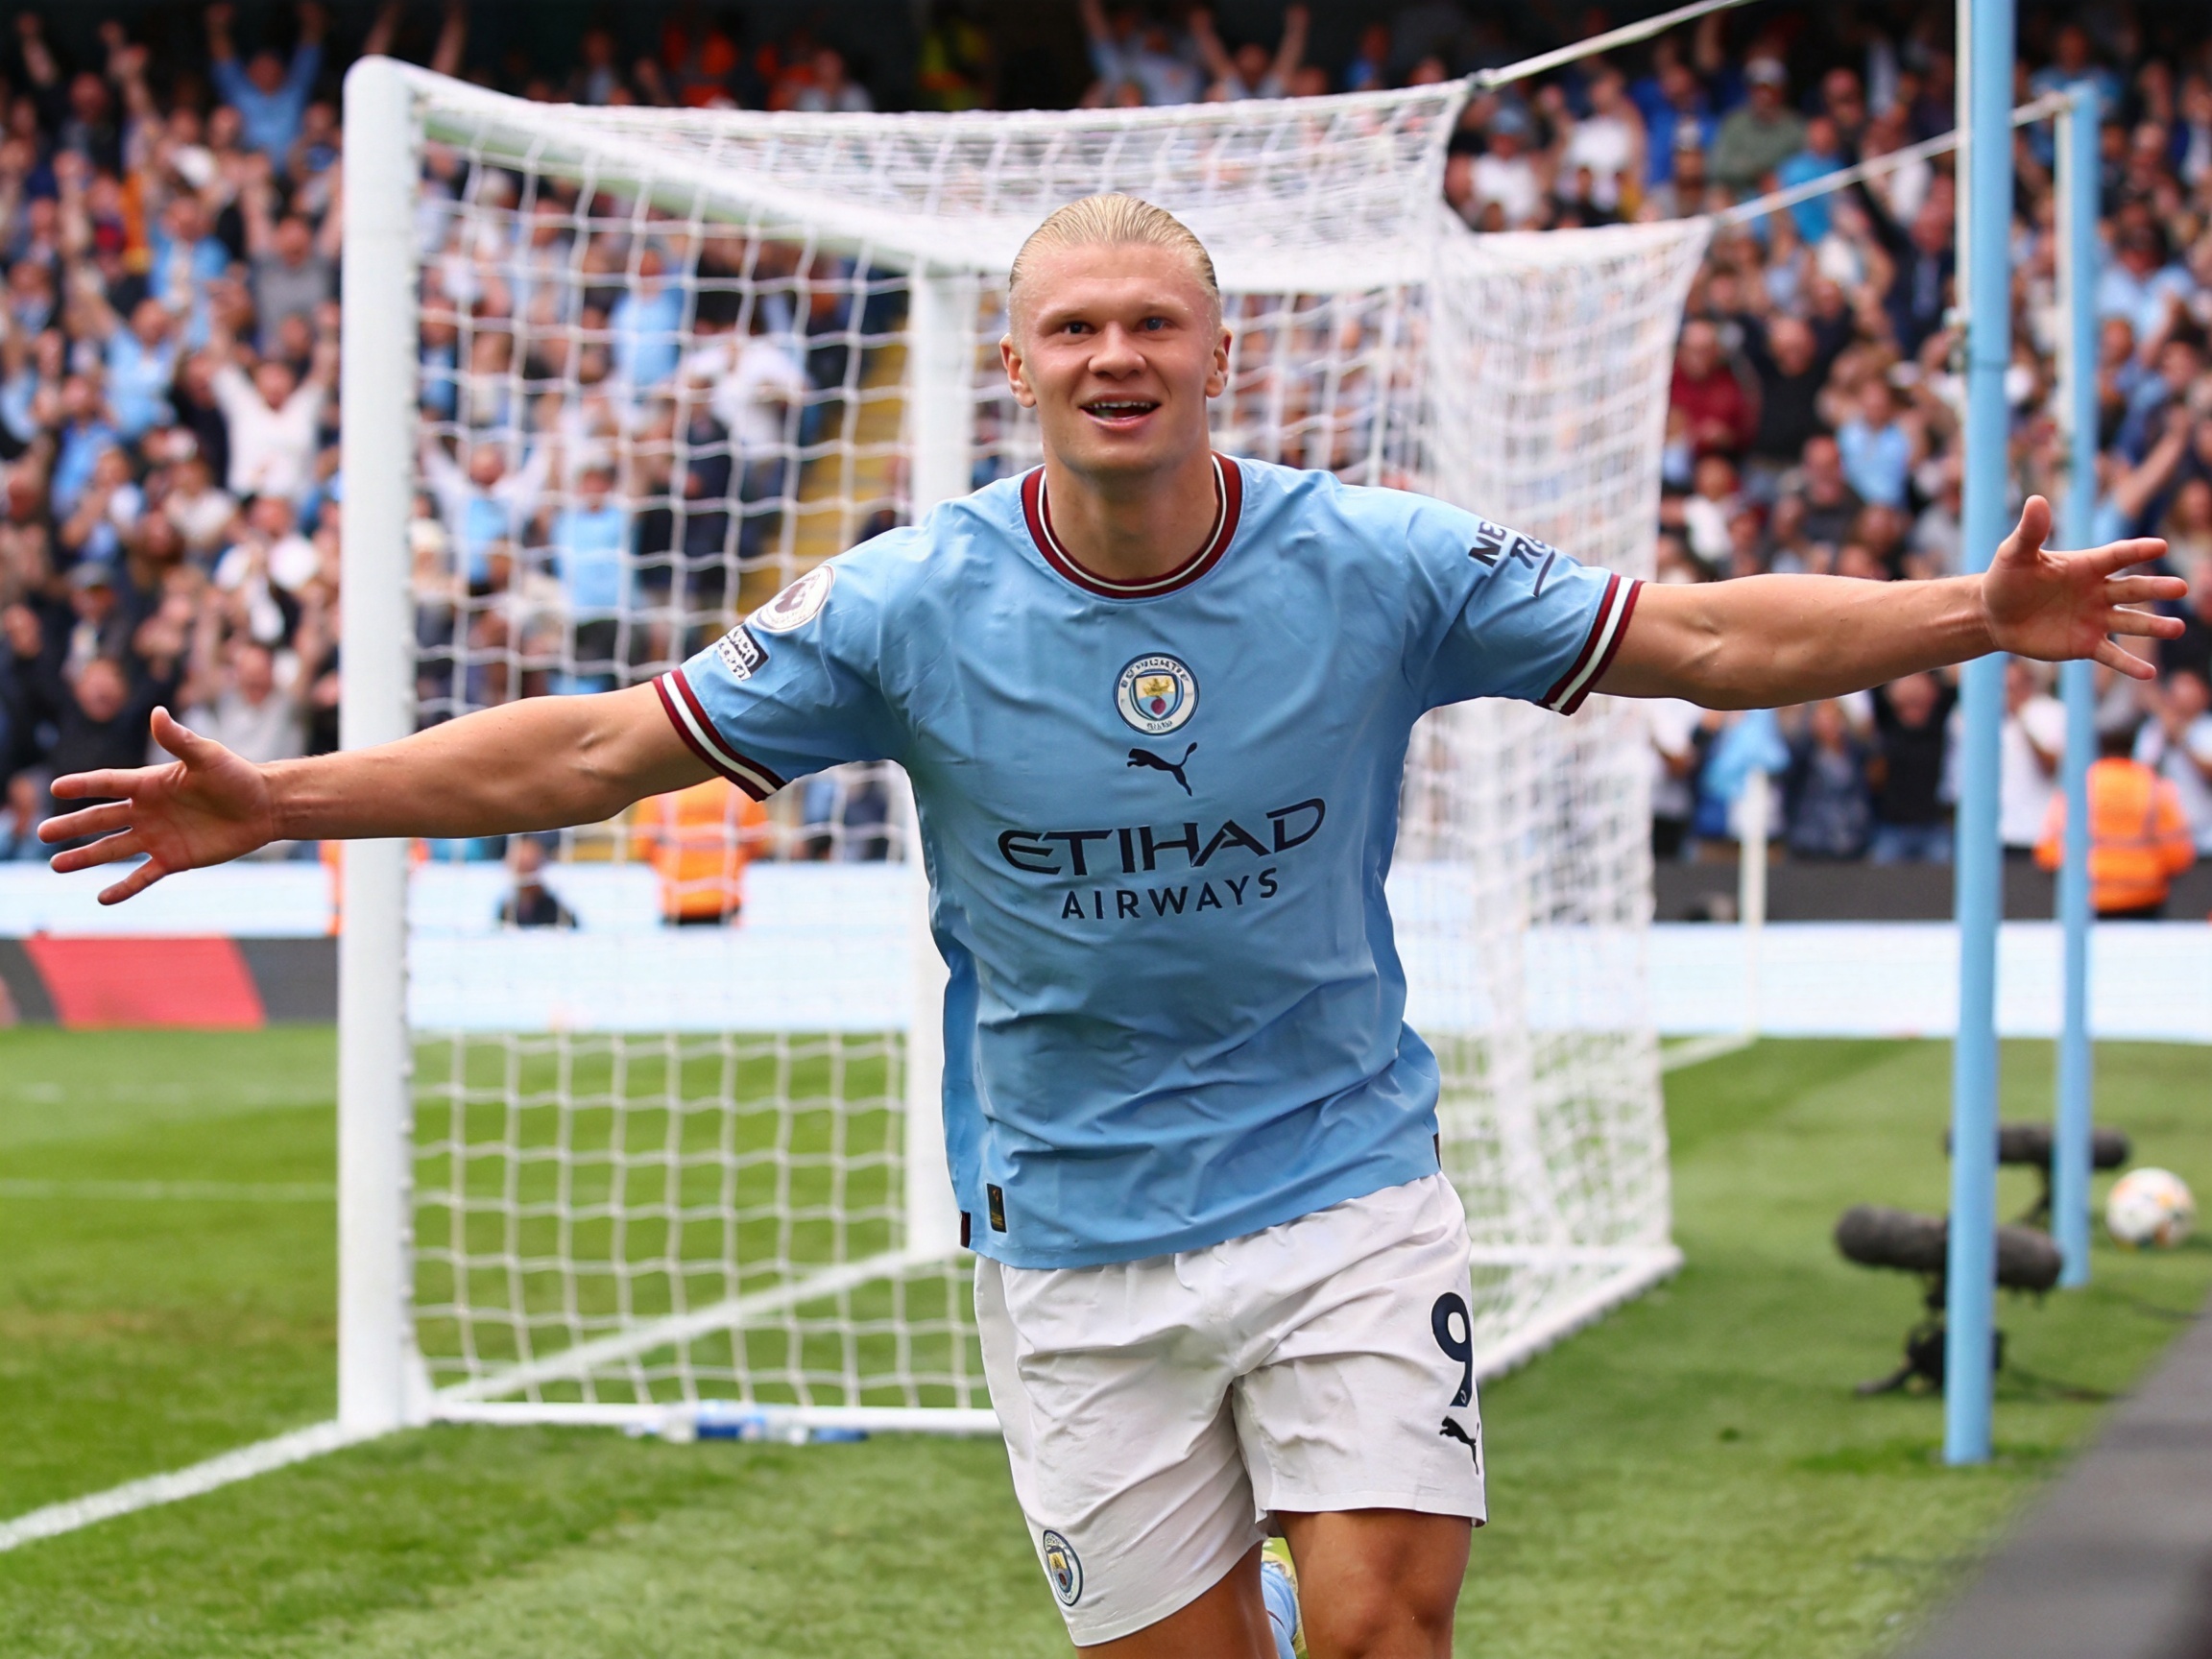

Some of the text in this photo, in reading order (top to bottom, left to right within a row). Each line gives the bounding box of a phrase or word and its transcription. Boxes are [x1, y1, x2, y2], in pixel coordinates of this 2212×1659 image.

[998, 798, 1326, 876] ETIHAD
[1061, 867, 1278, 919] AIRWAYS
[1431, 1291, 1473, 1407] 9
